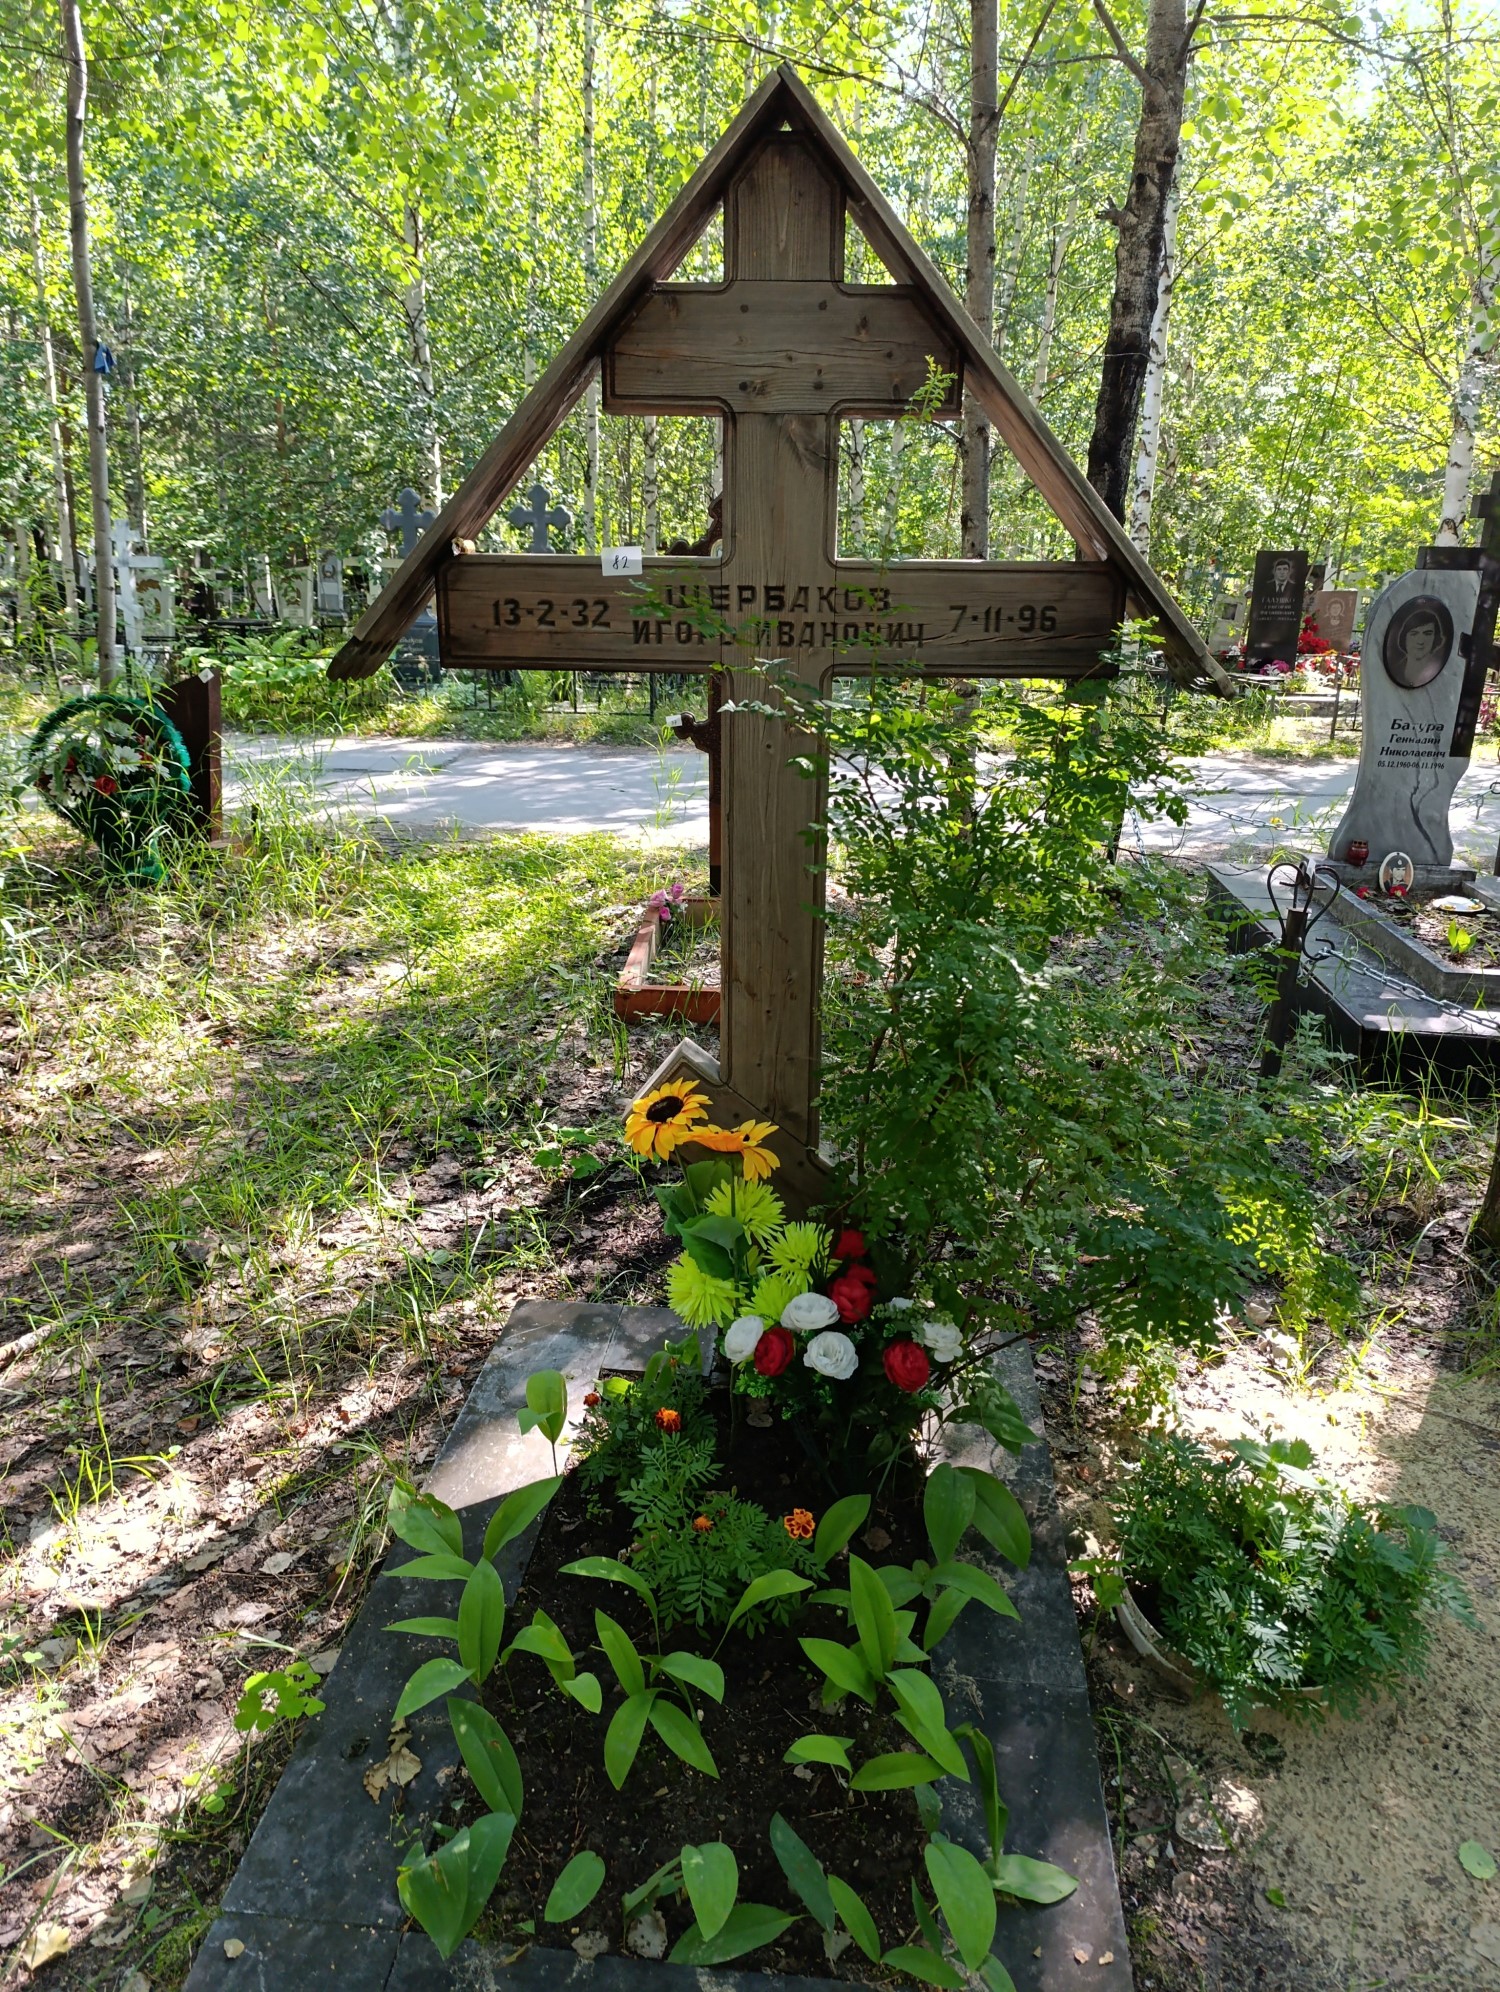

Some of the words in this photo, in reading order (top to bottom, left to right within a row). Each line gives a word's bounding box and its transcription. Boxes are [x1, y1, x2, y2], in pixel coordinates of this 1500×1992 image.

[612, 554, 630, 570] 82
[1390, 718, 1445, 733] Батура
[1379, 746, 1446, 758] Николаевич
